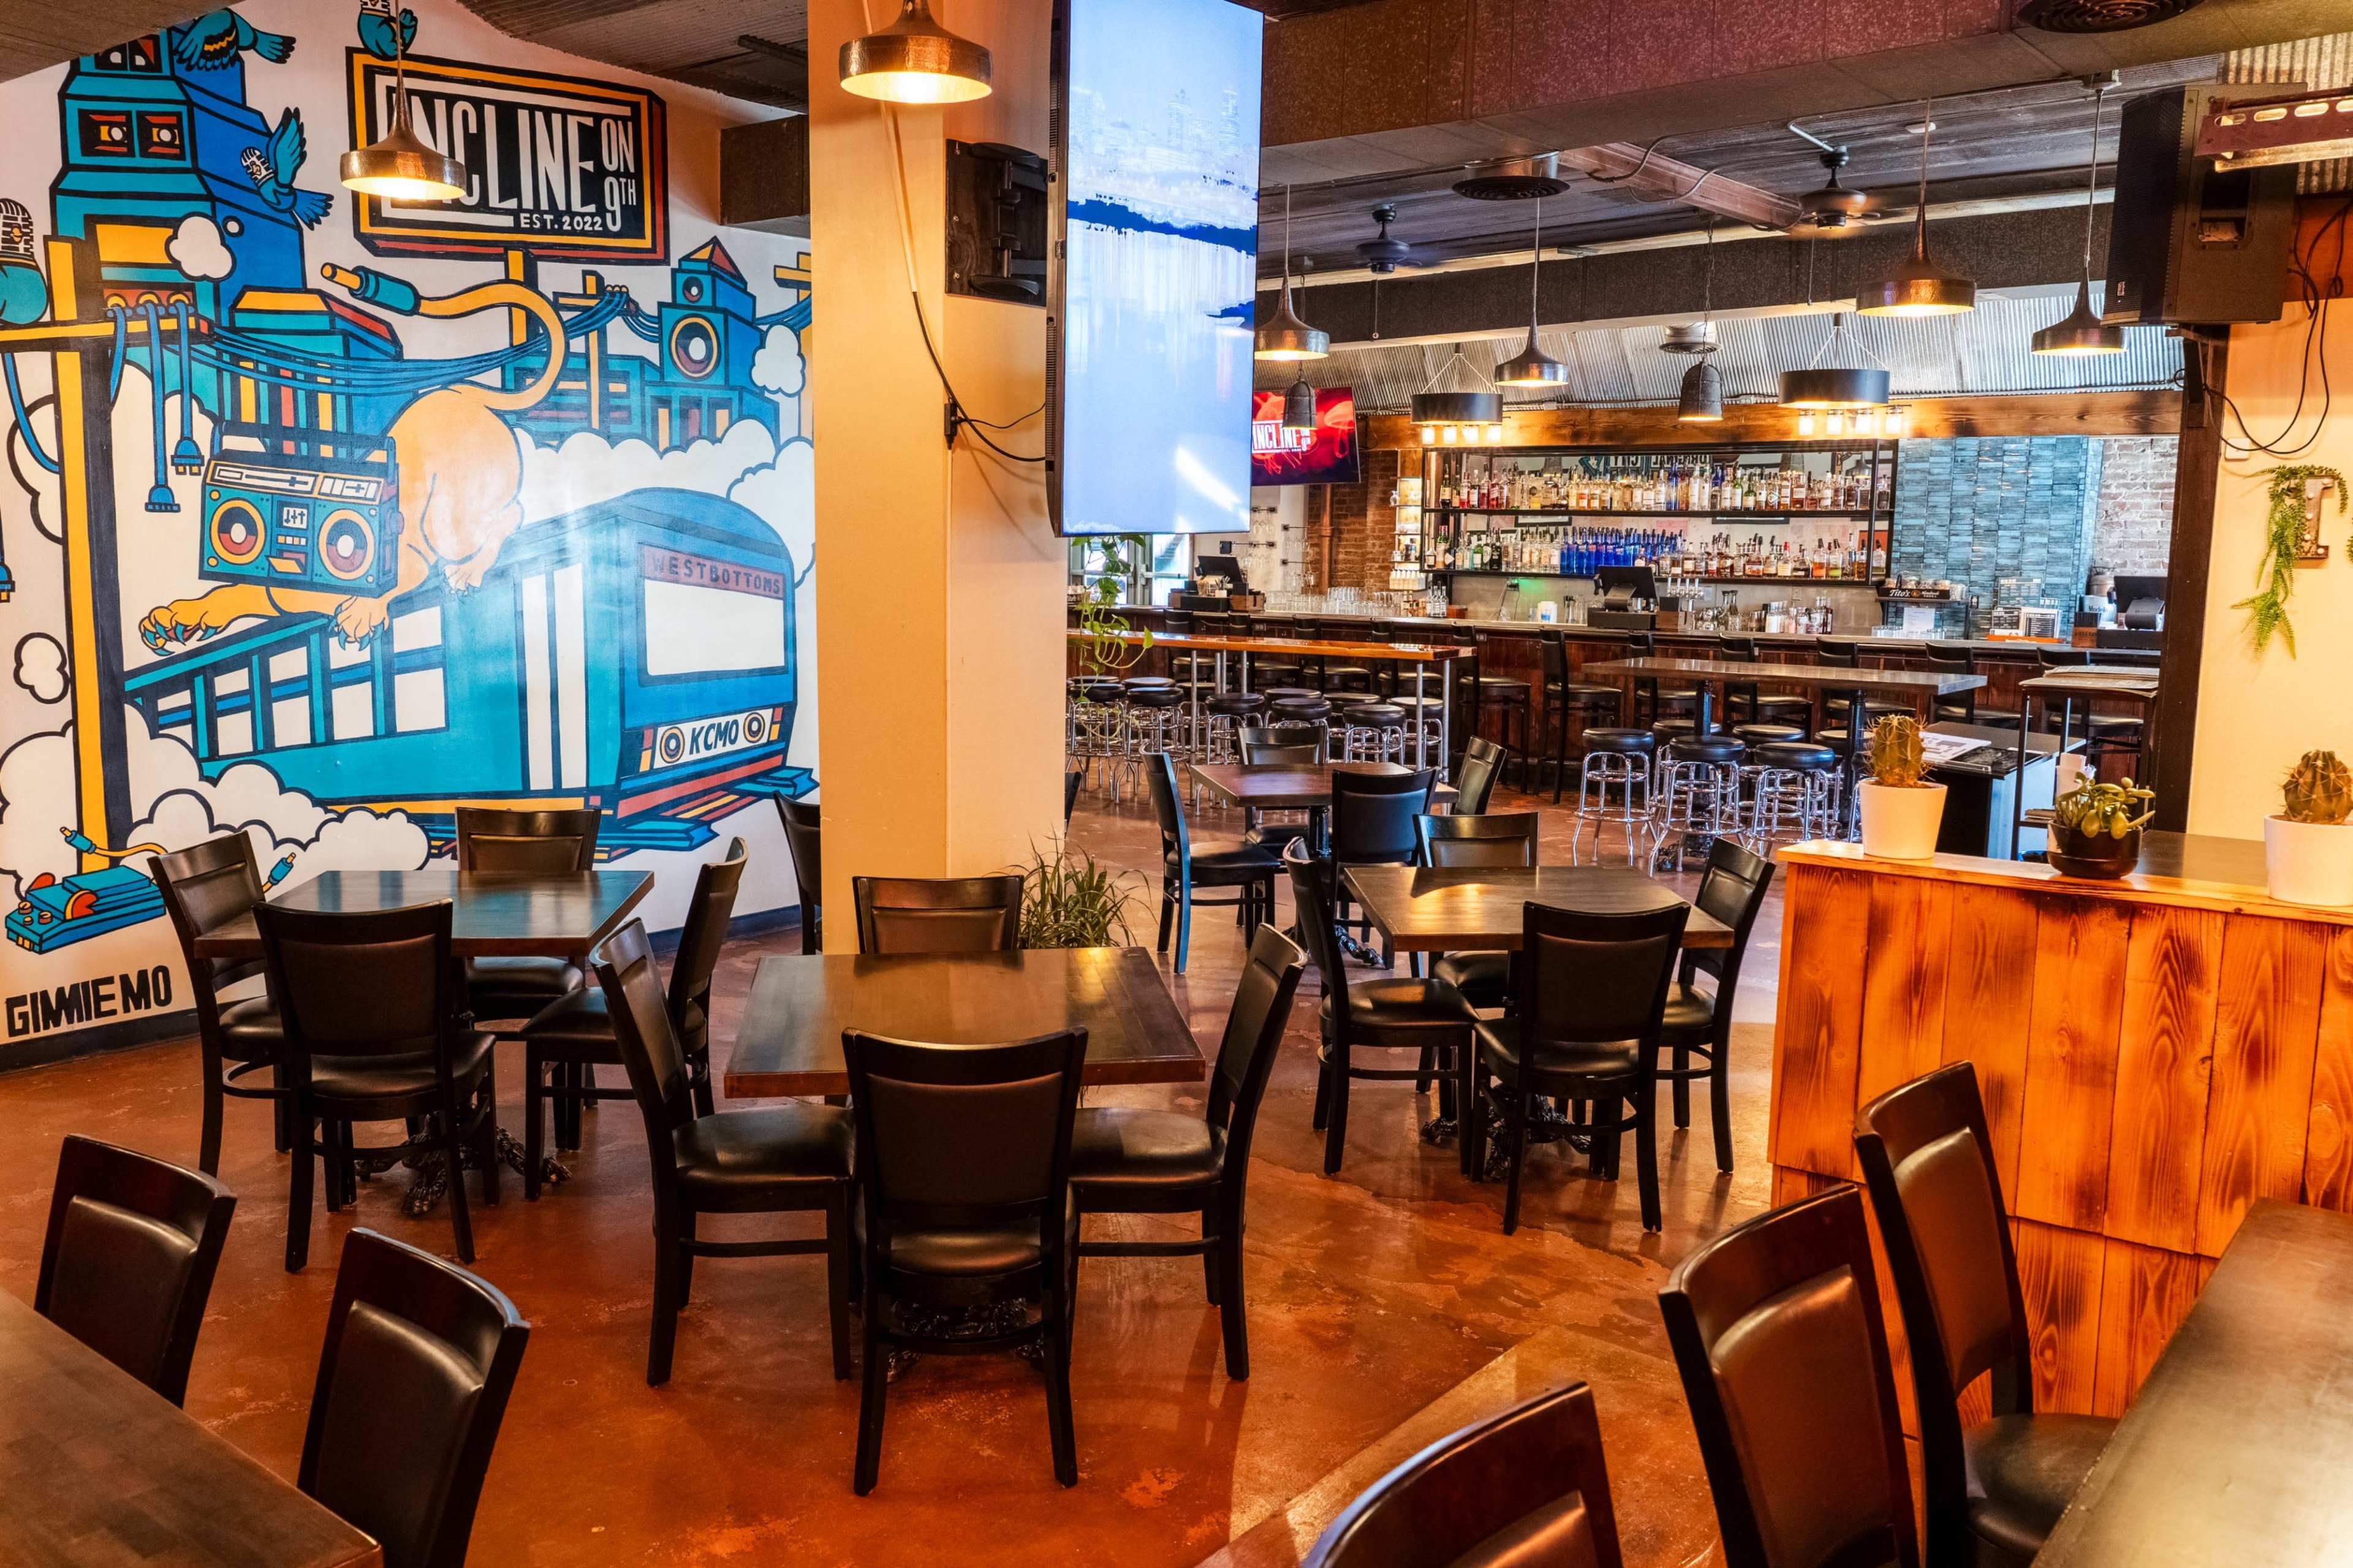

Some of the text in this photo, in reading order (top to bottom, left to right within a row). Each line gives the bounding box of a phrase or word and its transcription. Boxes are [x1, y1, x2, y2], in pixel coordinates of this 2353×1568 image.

[393, 93, 634, 213] NCLINE ON
[604, 176, 637, 232] 9TH
[520, 213, 604, 231] EST. 2022
[1252, 423, 1302, 450] INCLINE
[1889, 589, 1911, 597] Tito's
[689, 719, 739, 756] KCMO
